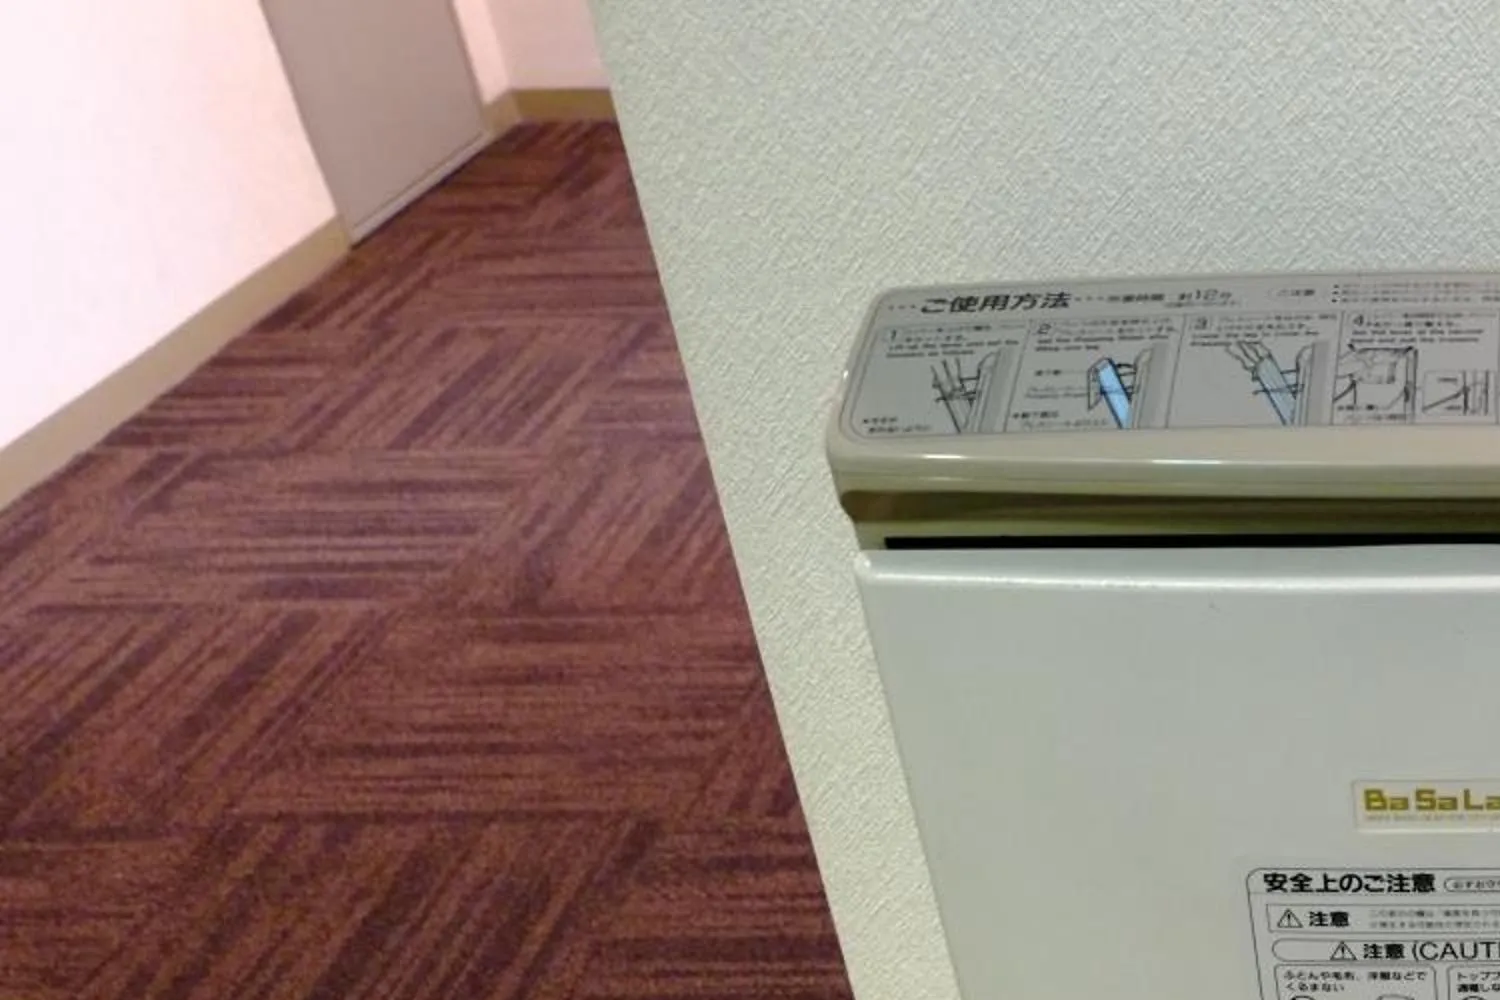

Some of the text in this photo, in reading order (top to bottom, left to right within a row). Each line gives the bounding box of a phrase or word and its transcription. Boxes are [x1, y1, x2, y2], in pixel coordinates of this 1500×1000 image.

[920, 291, 1071, 313] ご使用方法
[1263, 872, 1436, 894] 安全上のご注意
[1308, 911, 1350, 928] 注意
[1362, 942, 1405, 960] 注意
